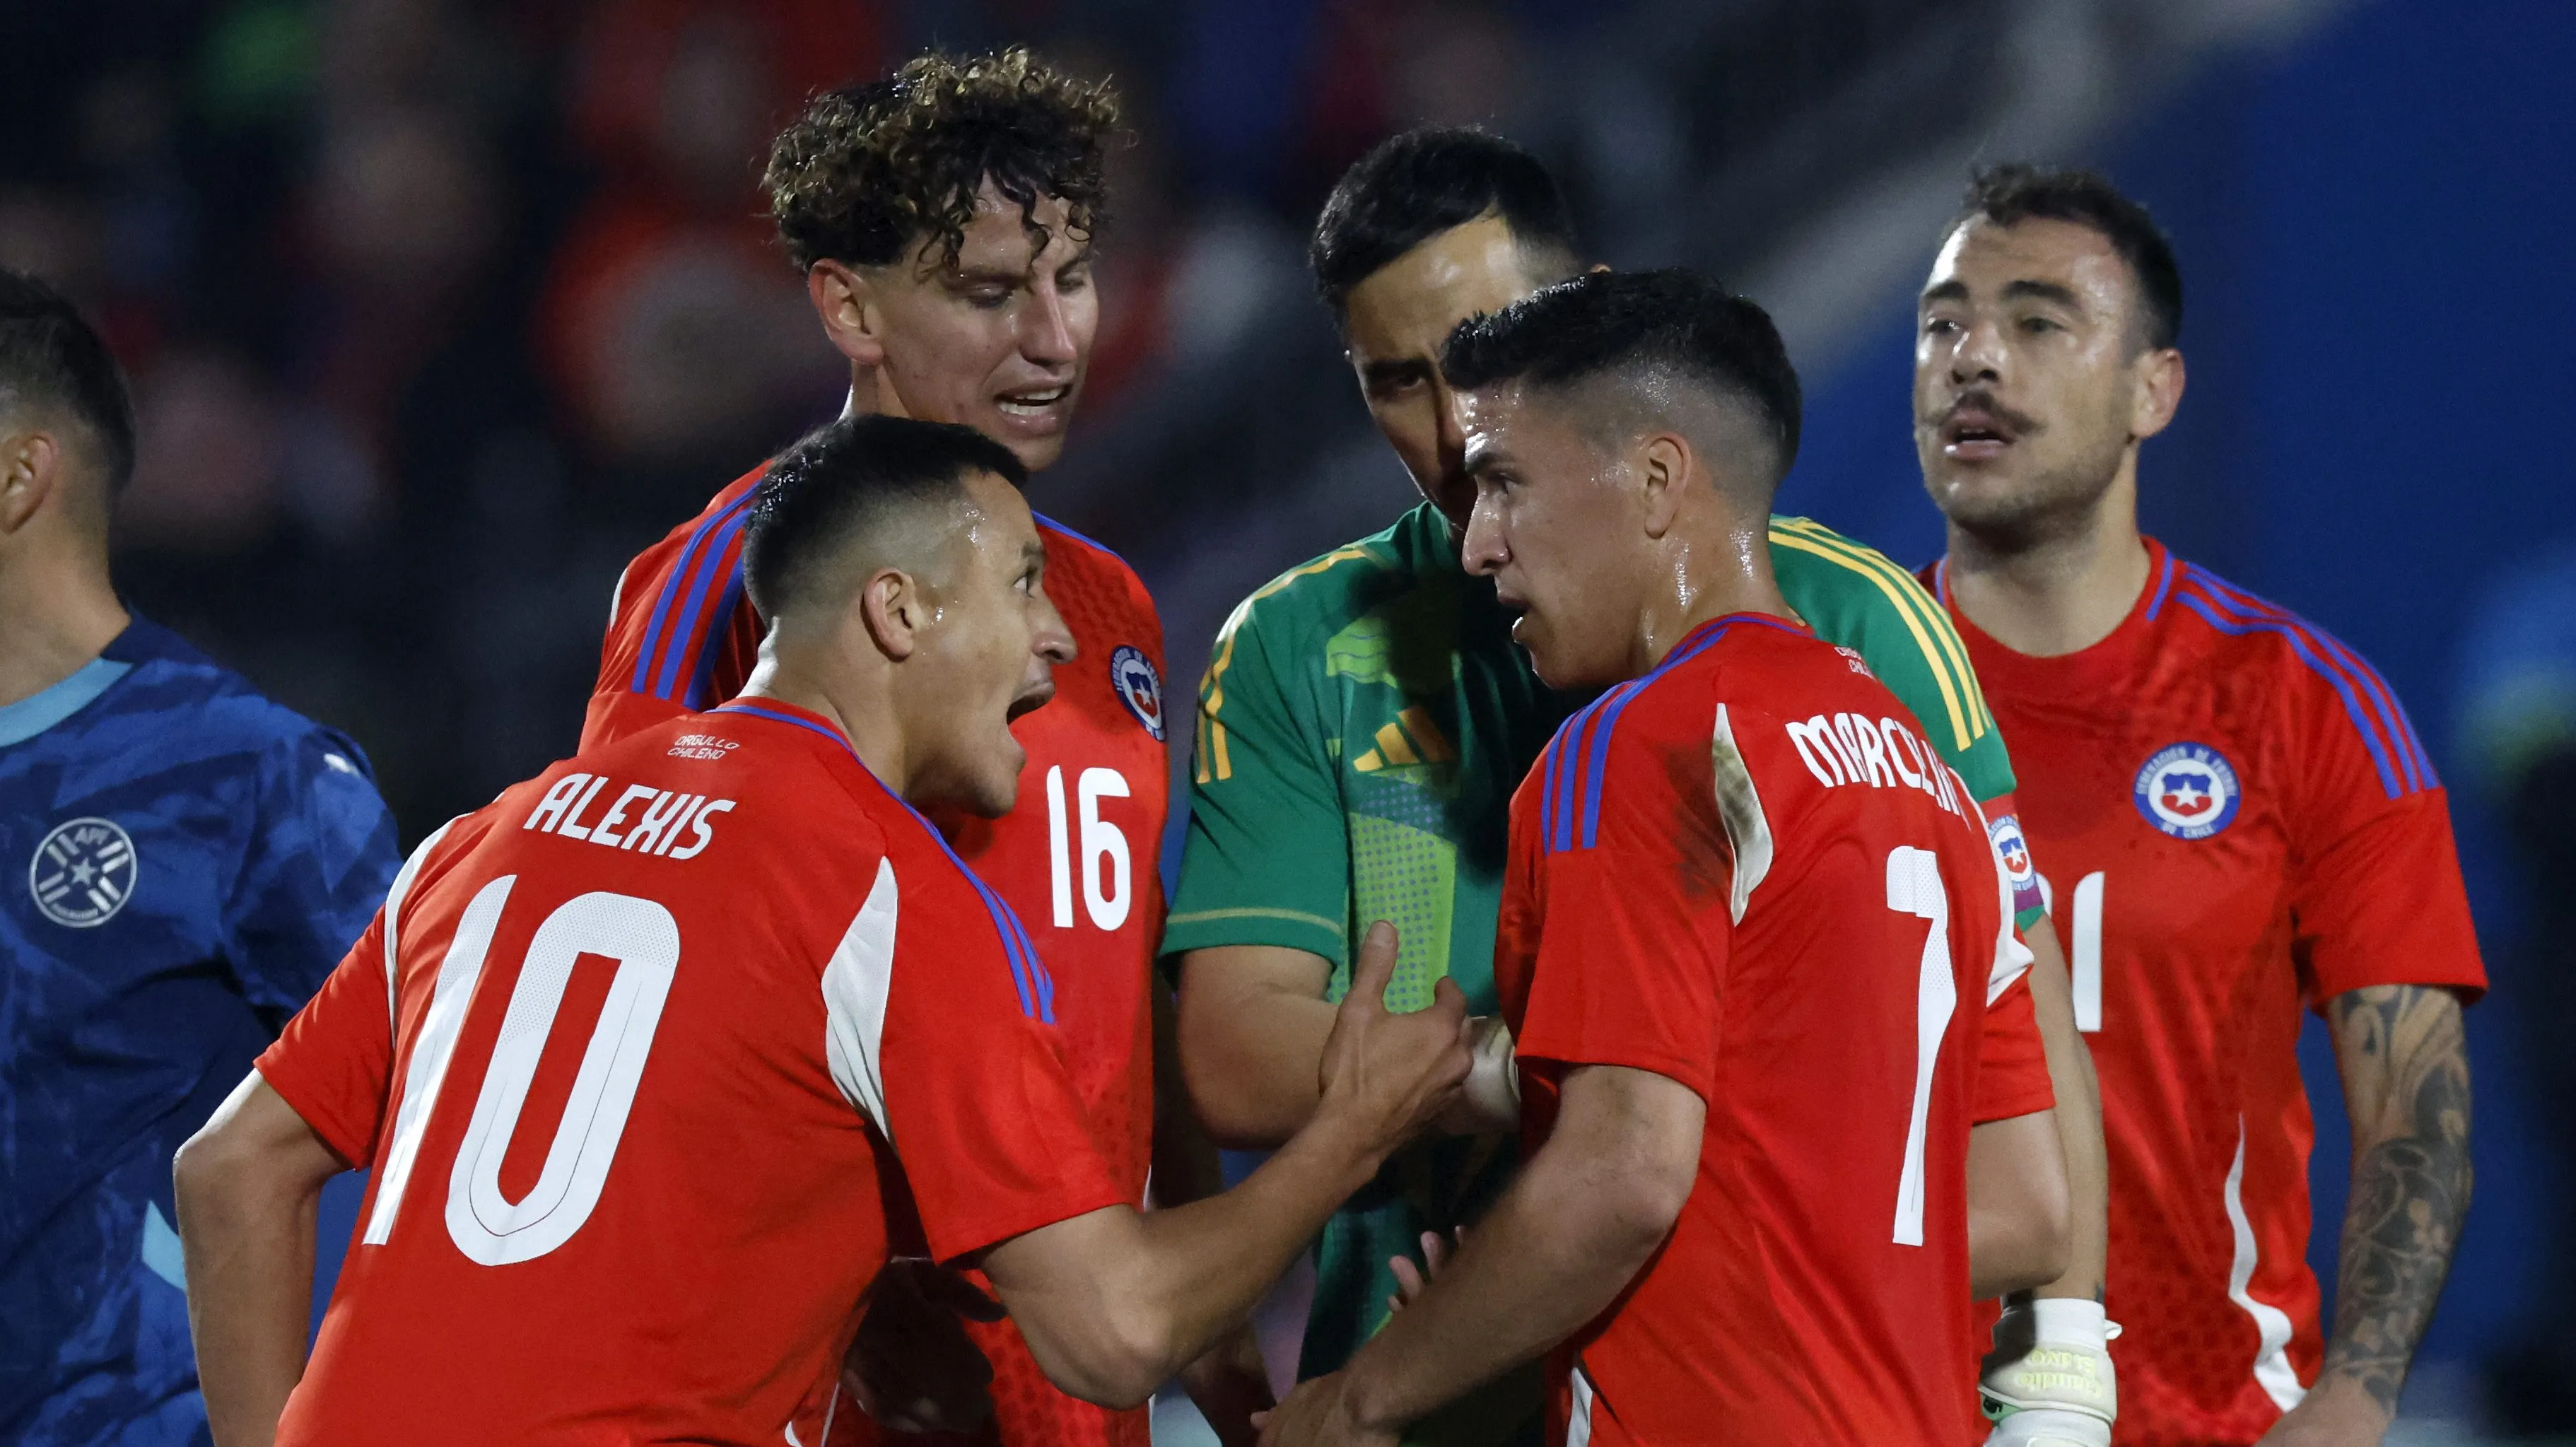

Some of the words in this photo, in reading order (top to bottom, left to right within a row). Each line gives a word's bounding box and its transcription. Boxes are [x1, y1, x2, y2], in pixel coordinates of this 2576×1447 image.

[523, 772, 737, 861] ALEXIS
[667, 746, 726, 761] CHILENO
[674, 734, 740, 750] ORGULLO
[1046, 764, 1132, 932] 16
[2036, 871, 2105, 1032] 1
[362, 874, 680, 1267] 10
[1886, 845, 1957, 1247] 7
